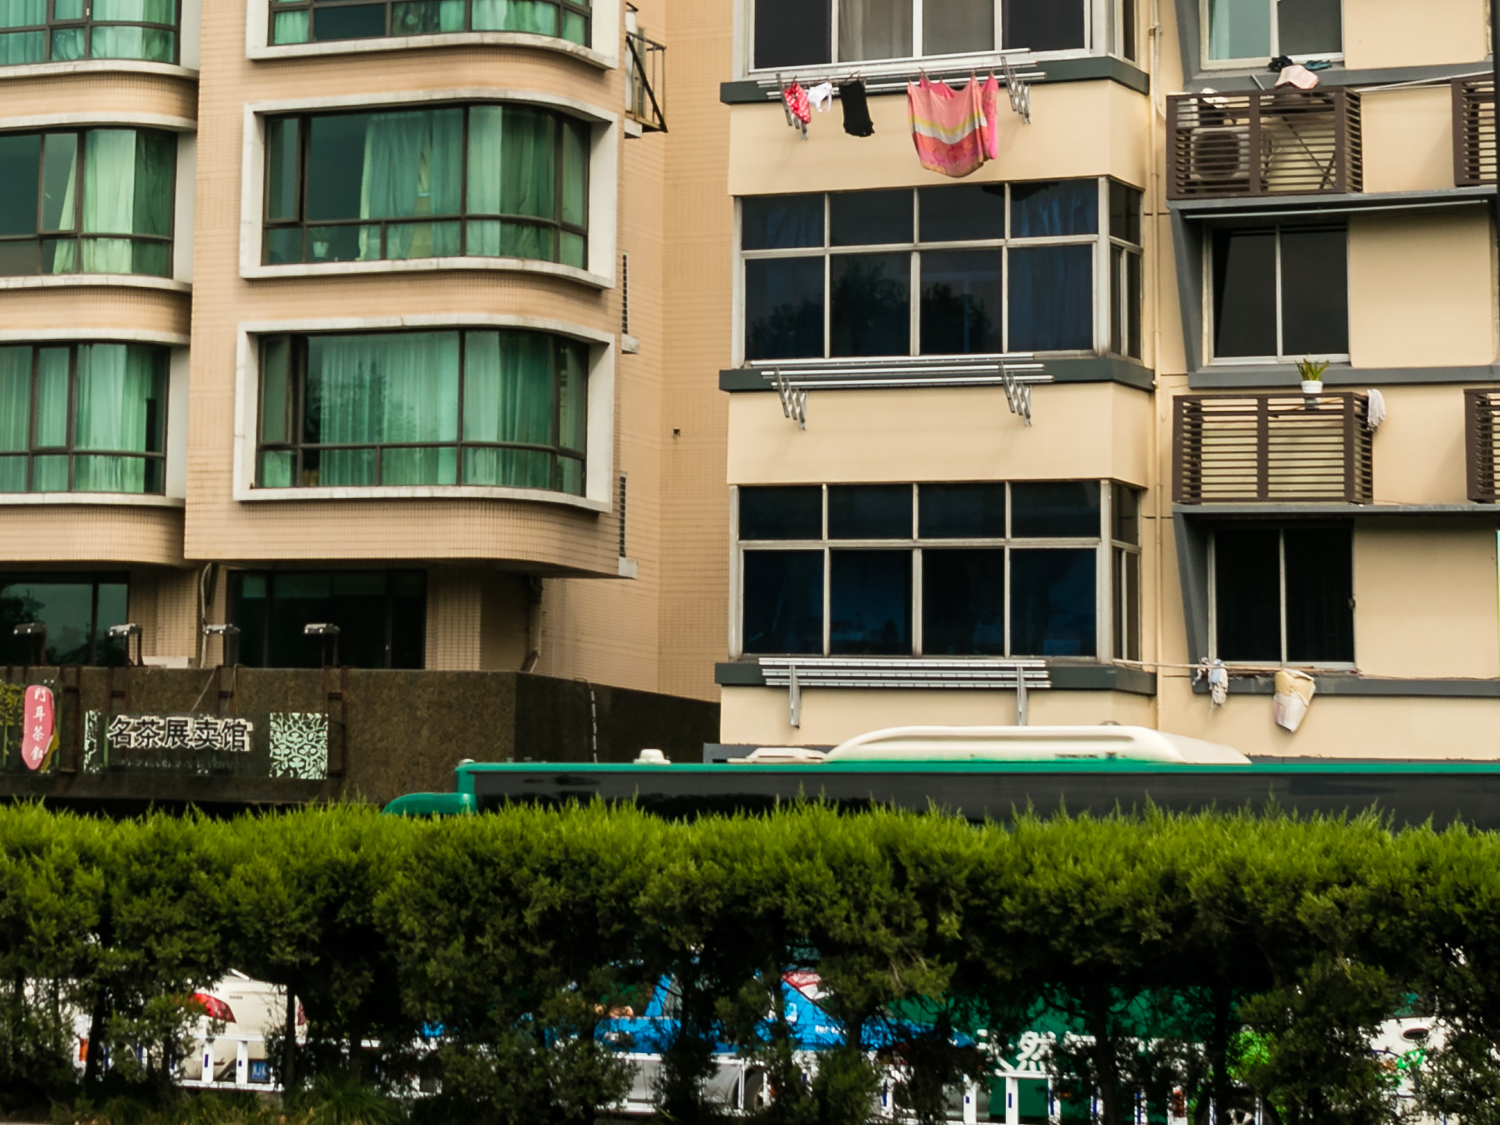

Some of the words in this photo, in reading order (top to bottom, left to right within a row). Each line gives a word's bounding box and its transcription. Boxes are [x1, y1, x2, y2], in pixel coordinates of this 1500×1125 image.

[108, 714, 254, 752] 名茶展卖馆
